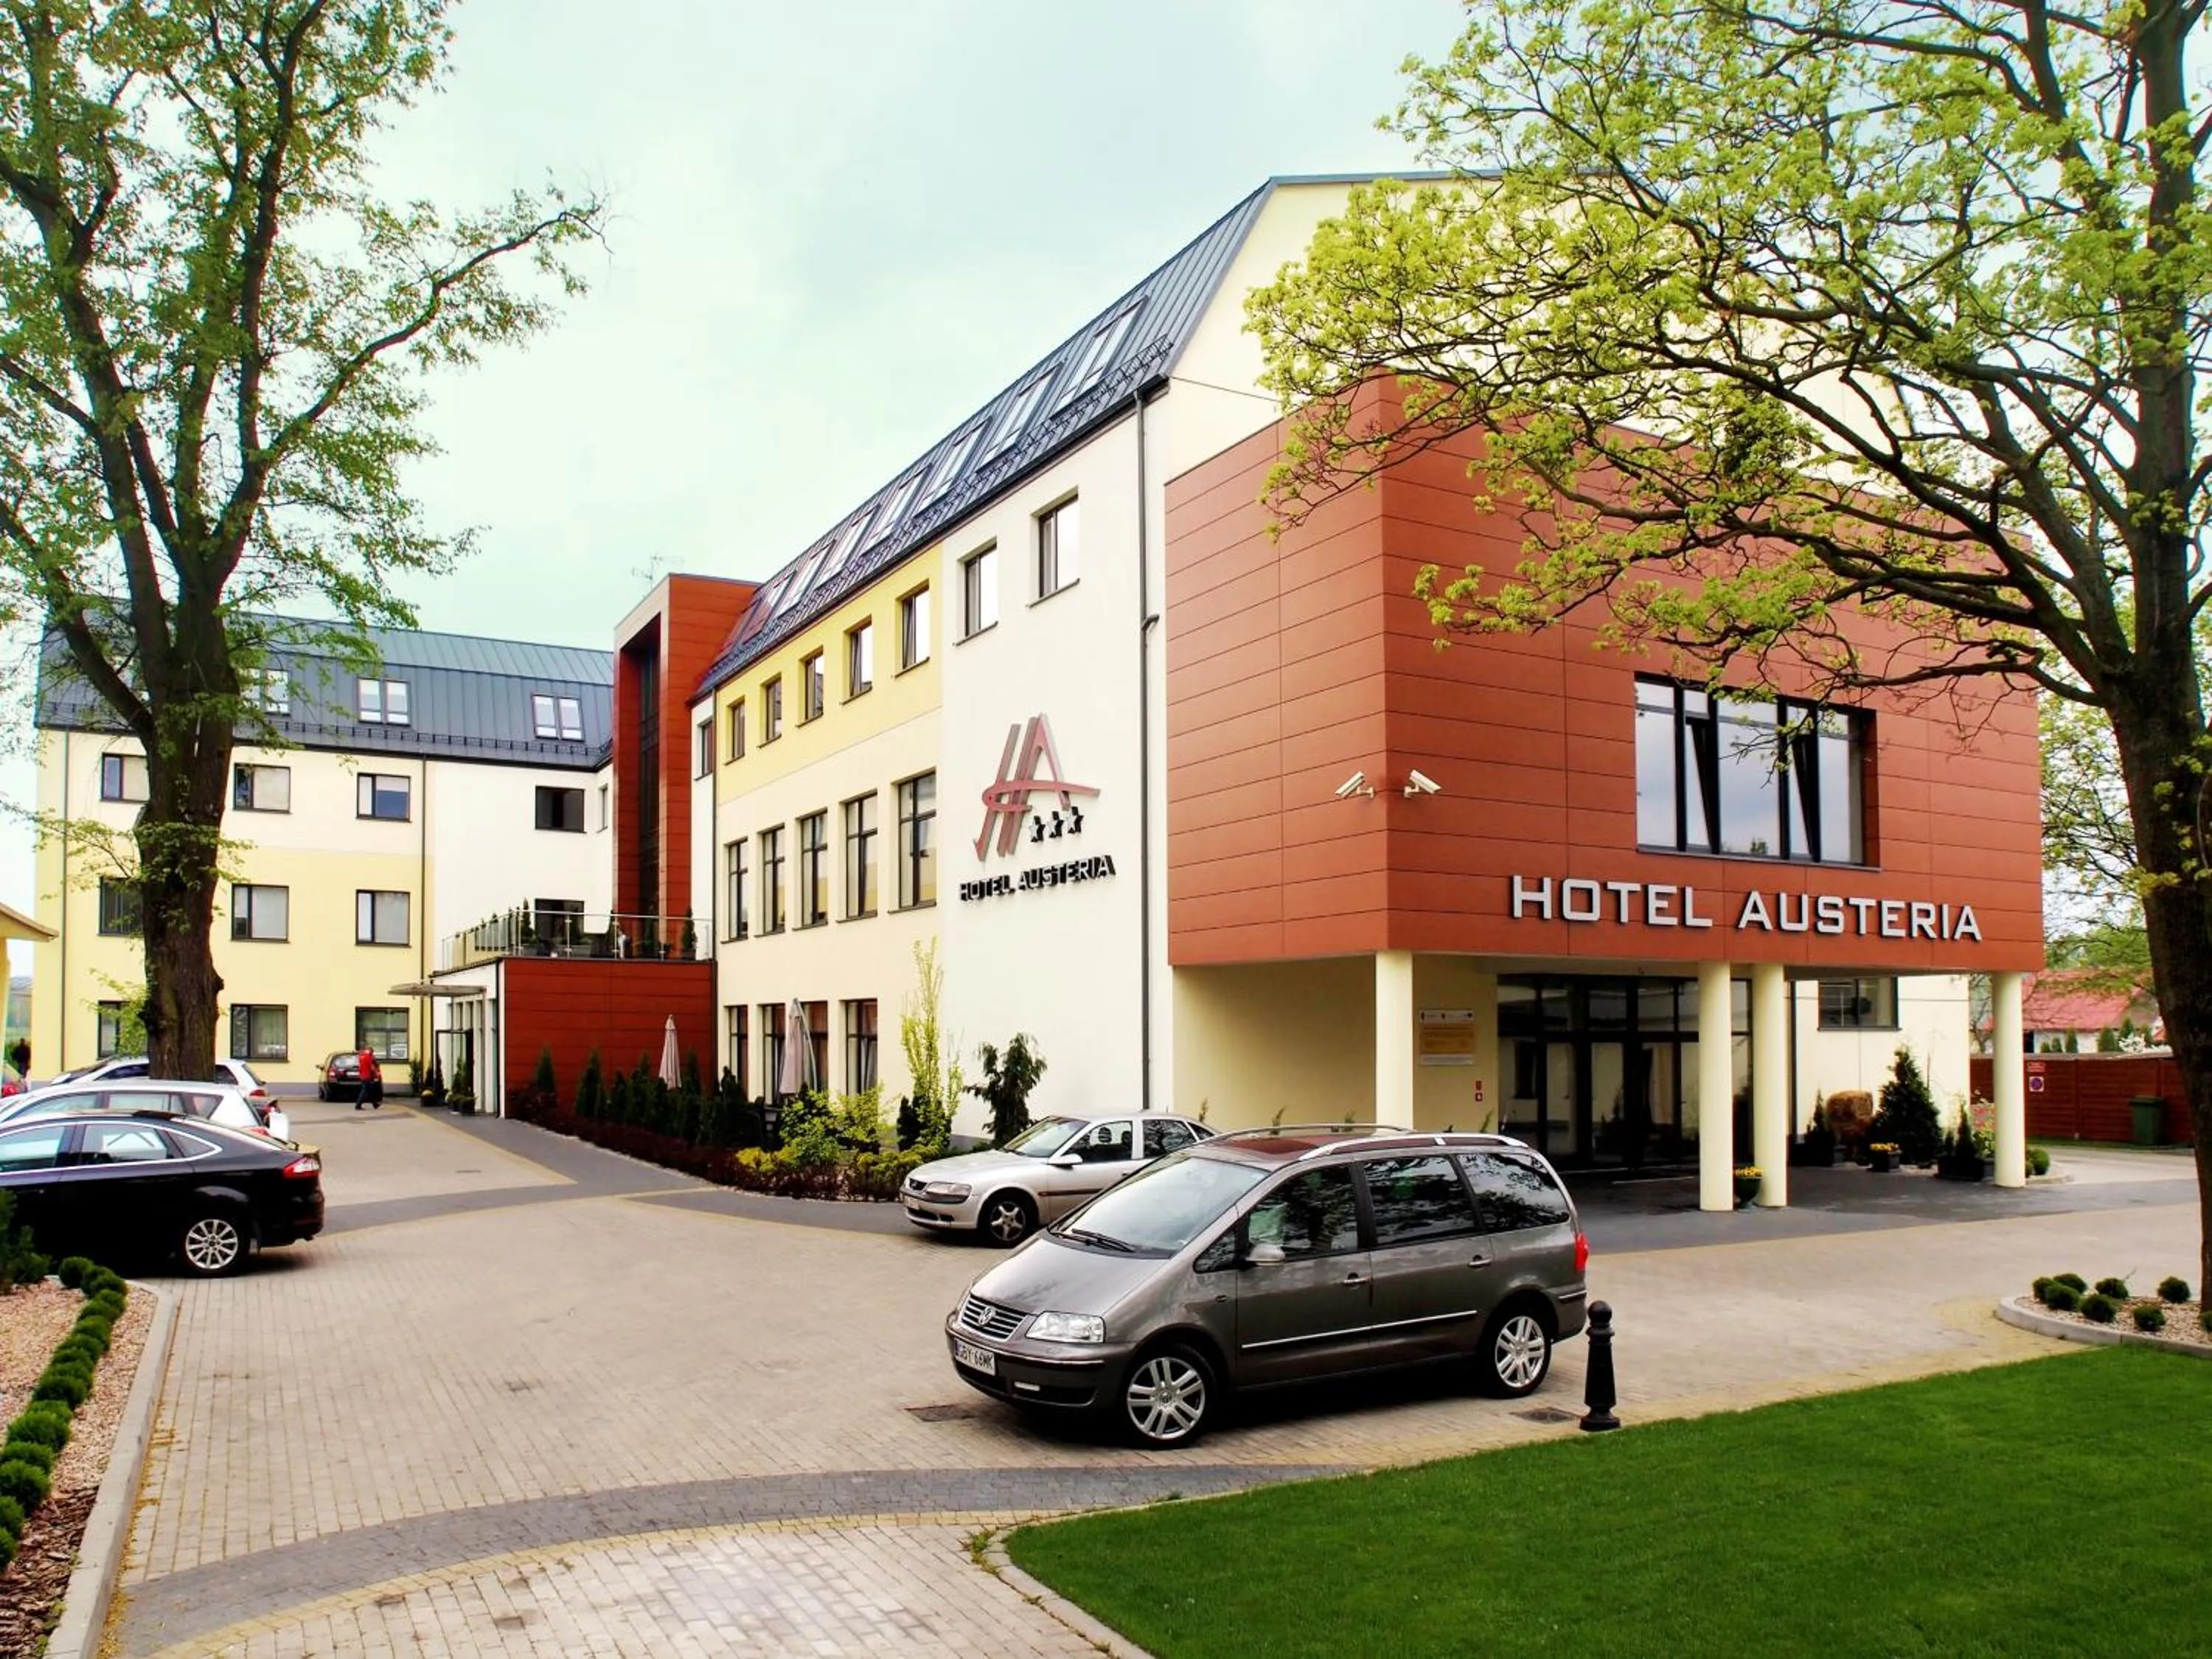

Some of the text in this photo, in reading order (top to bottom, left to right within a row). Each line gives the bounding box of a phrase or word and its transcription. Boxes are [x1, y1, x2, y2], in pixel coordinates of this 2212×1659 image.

[960, 855, 1116, 901] HOTEL AUSTERIA
[1512, 874, 1983, 942] HOTEL AUSTERIA
